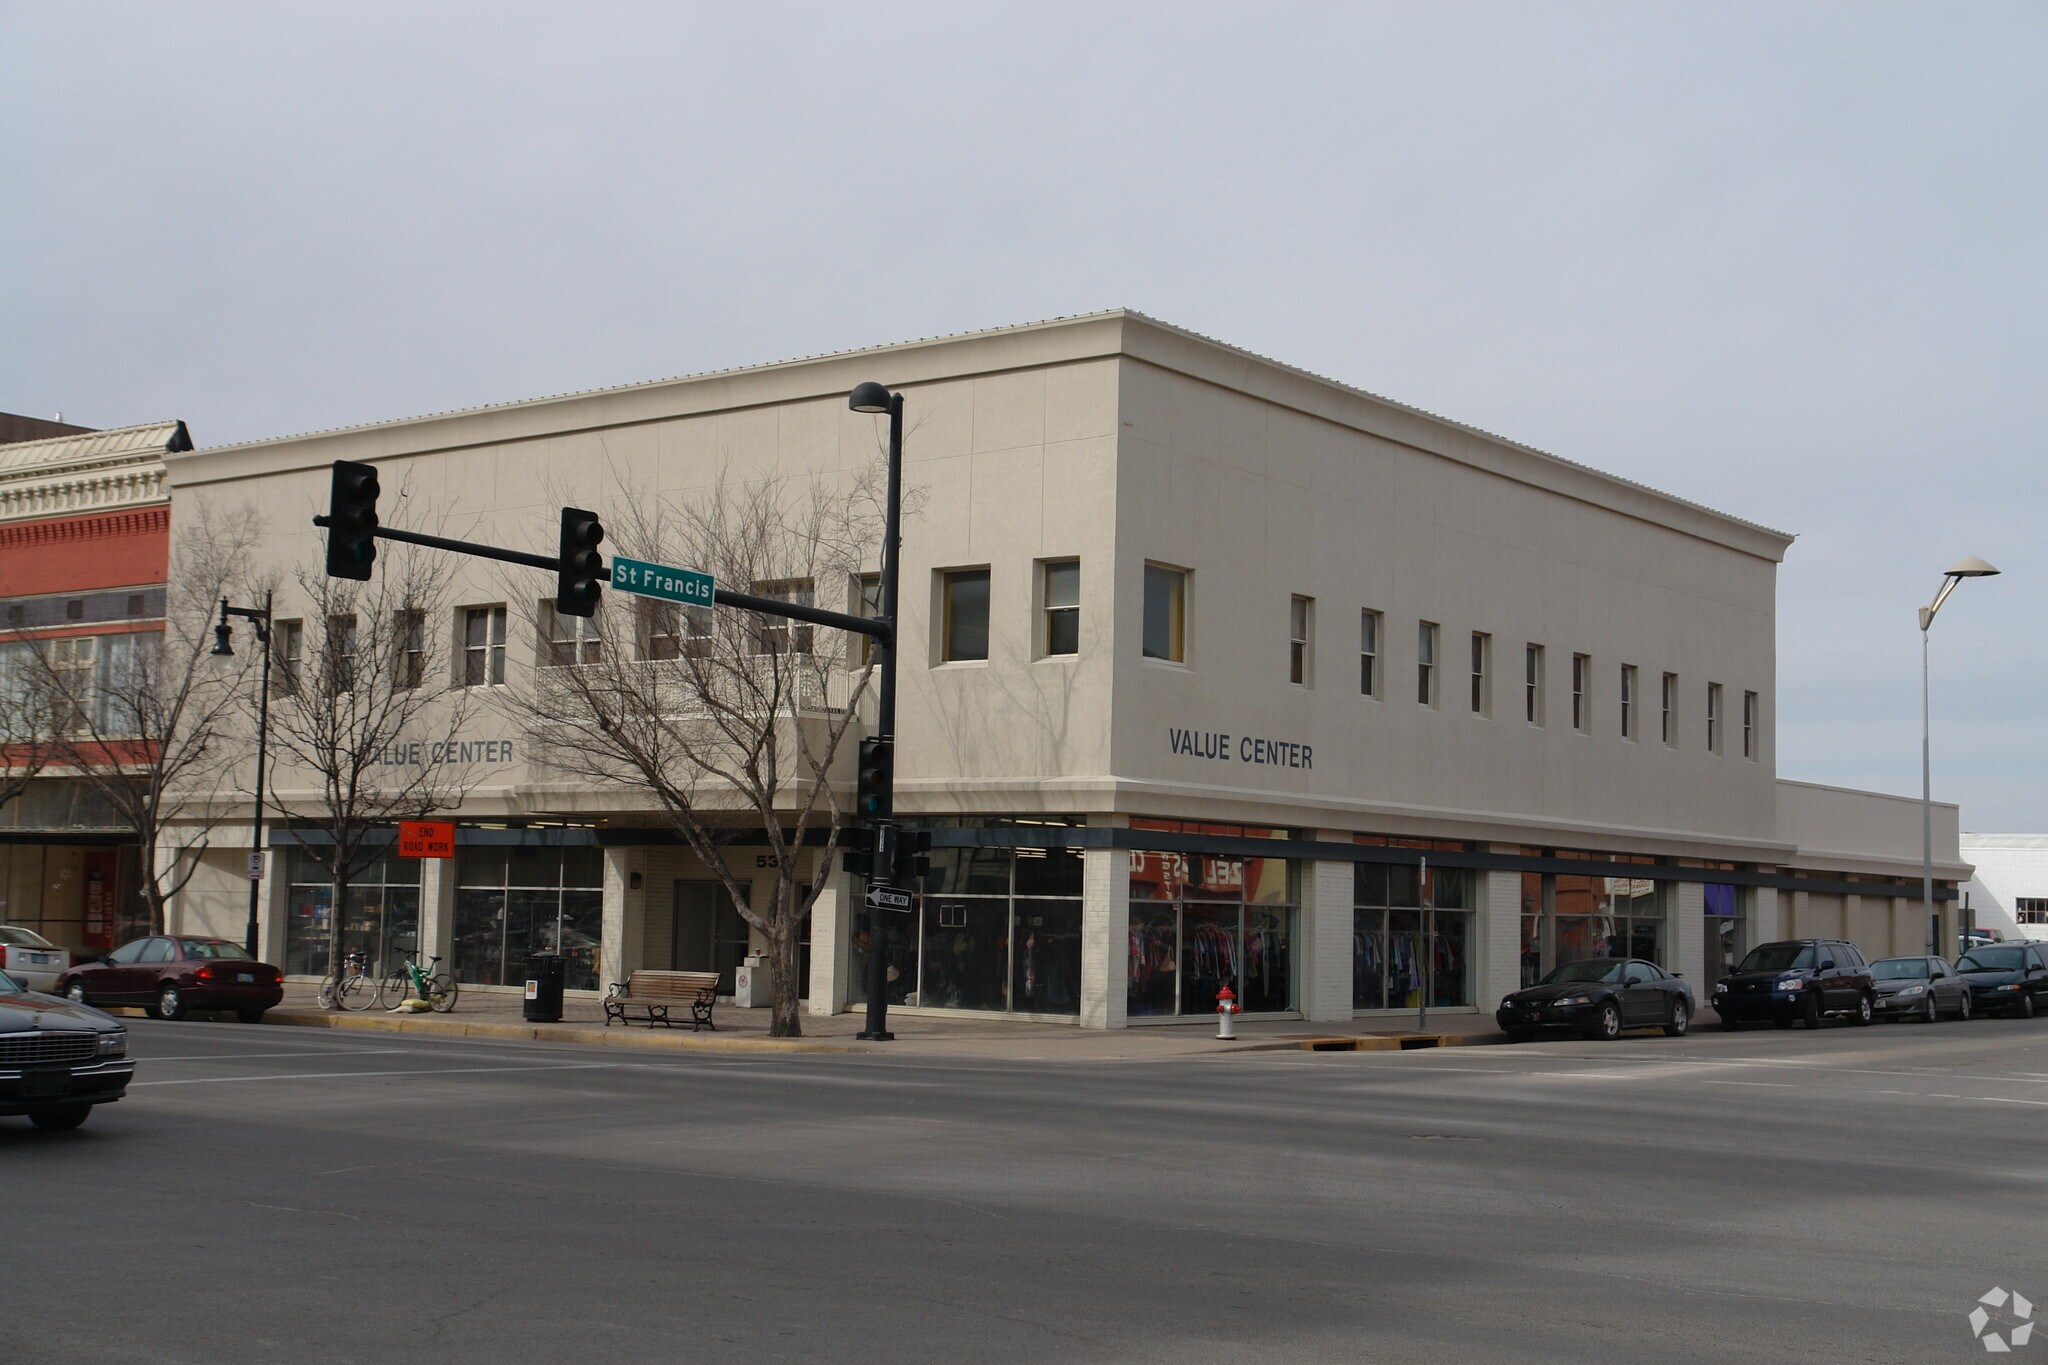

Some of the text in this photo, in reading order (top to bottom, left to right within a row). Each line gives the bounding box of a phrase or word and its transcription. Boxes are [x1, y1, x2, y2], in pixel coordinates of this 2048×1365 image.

[616, 565, 710, 598] St Francis
[431, 740, 513, 764] CENTER
[1169, 727, 1313, 769] VALUE CENTER
[419, 827, 434, 838] END
[403, 841, 449, 853] ROAD WORK
[756, 855, 790, 868] 53
[880, 893, 907, 906] ONE WAY
